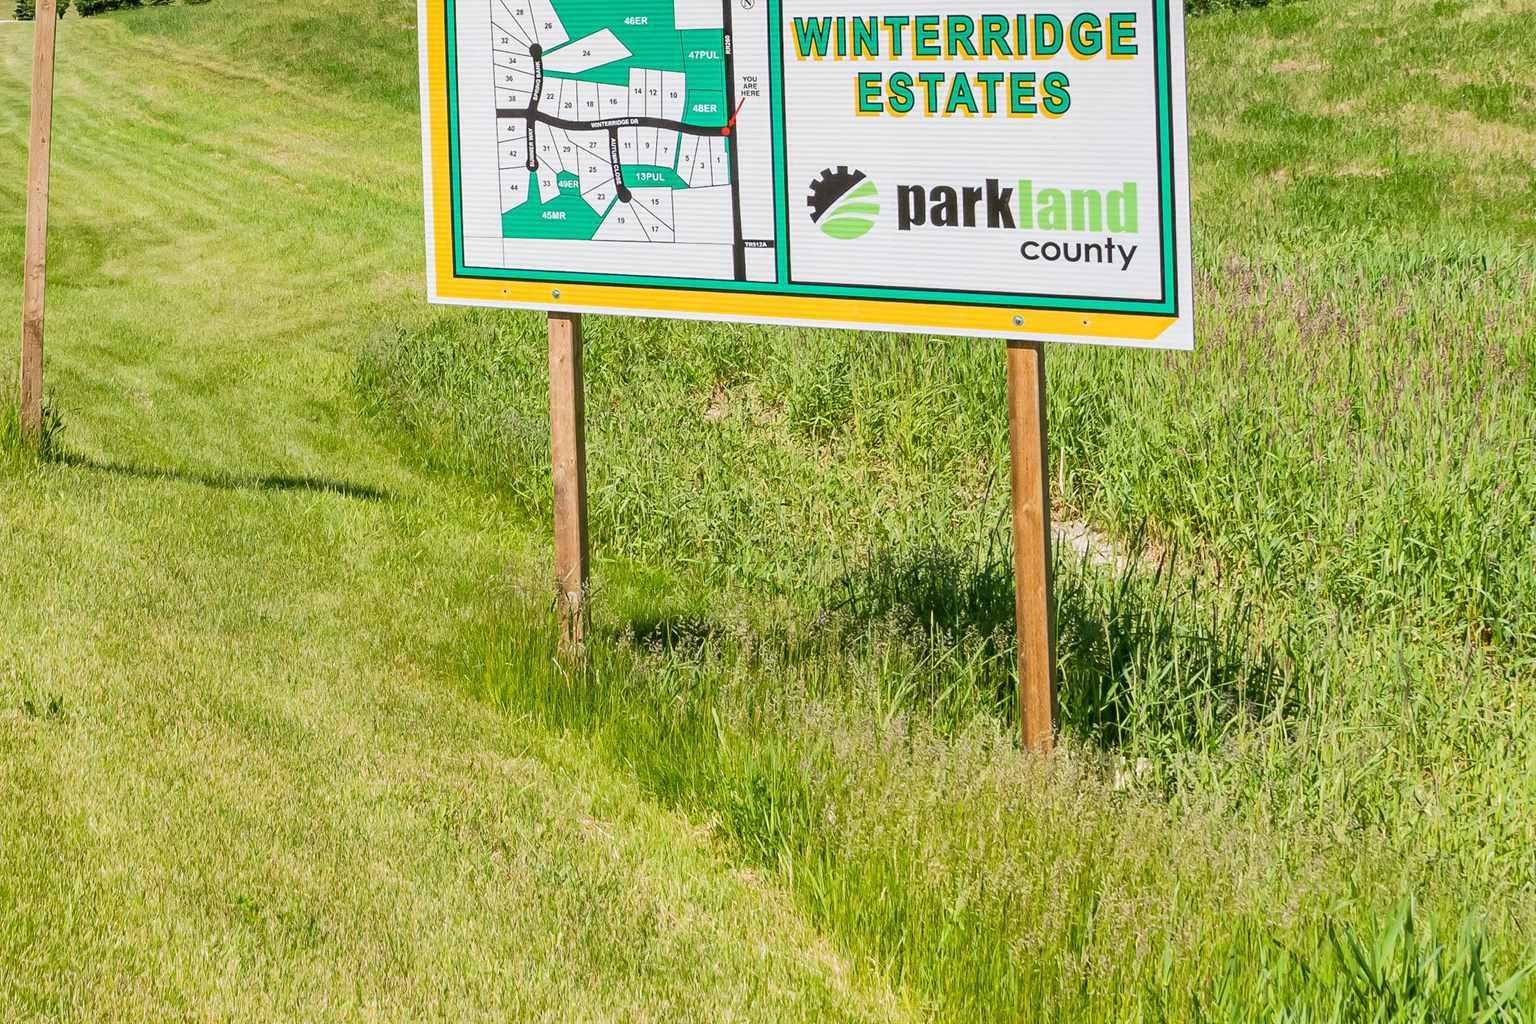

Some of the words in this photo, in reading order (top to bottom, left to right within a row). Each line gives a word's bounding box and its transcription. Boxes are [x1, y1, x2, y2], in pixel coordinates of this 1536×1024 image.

[516, 8, 524, 16] 28
[624, 16, 648, 25] 46ER
[544, 22, 552, 30] 26
[790, 12, 1139, 61] WINTERRIDGE
[688, 51, 719, 59] 47PUL
[508, 57, 517, 65] 34
[634, 87, 642, 95] 14
[854, 71, 1071, 119] ESTATES
[692, 104, 718, 113] 48ER
[589, 141, 597, 149] 27
[636, 173, 665, 181] 13PUL
[558, 179, 579, 189] 49ER
[651, 198, 659, 206] 15
[897, 178, 1140, 234] parkland
[542, 211, 566, 220] 45MR
[1020, 237, 1138, 271] county
